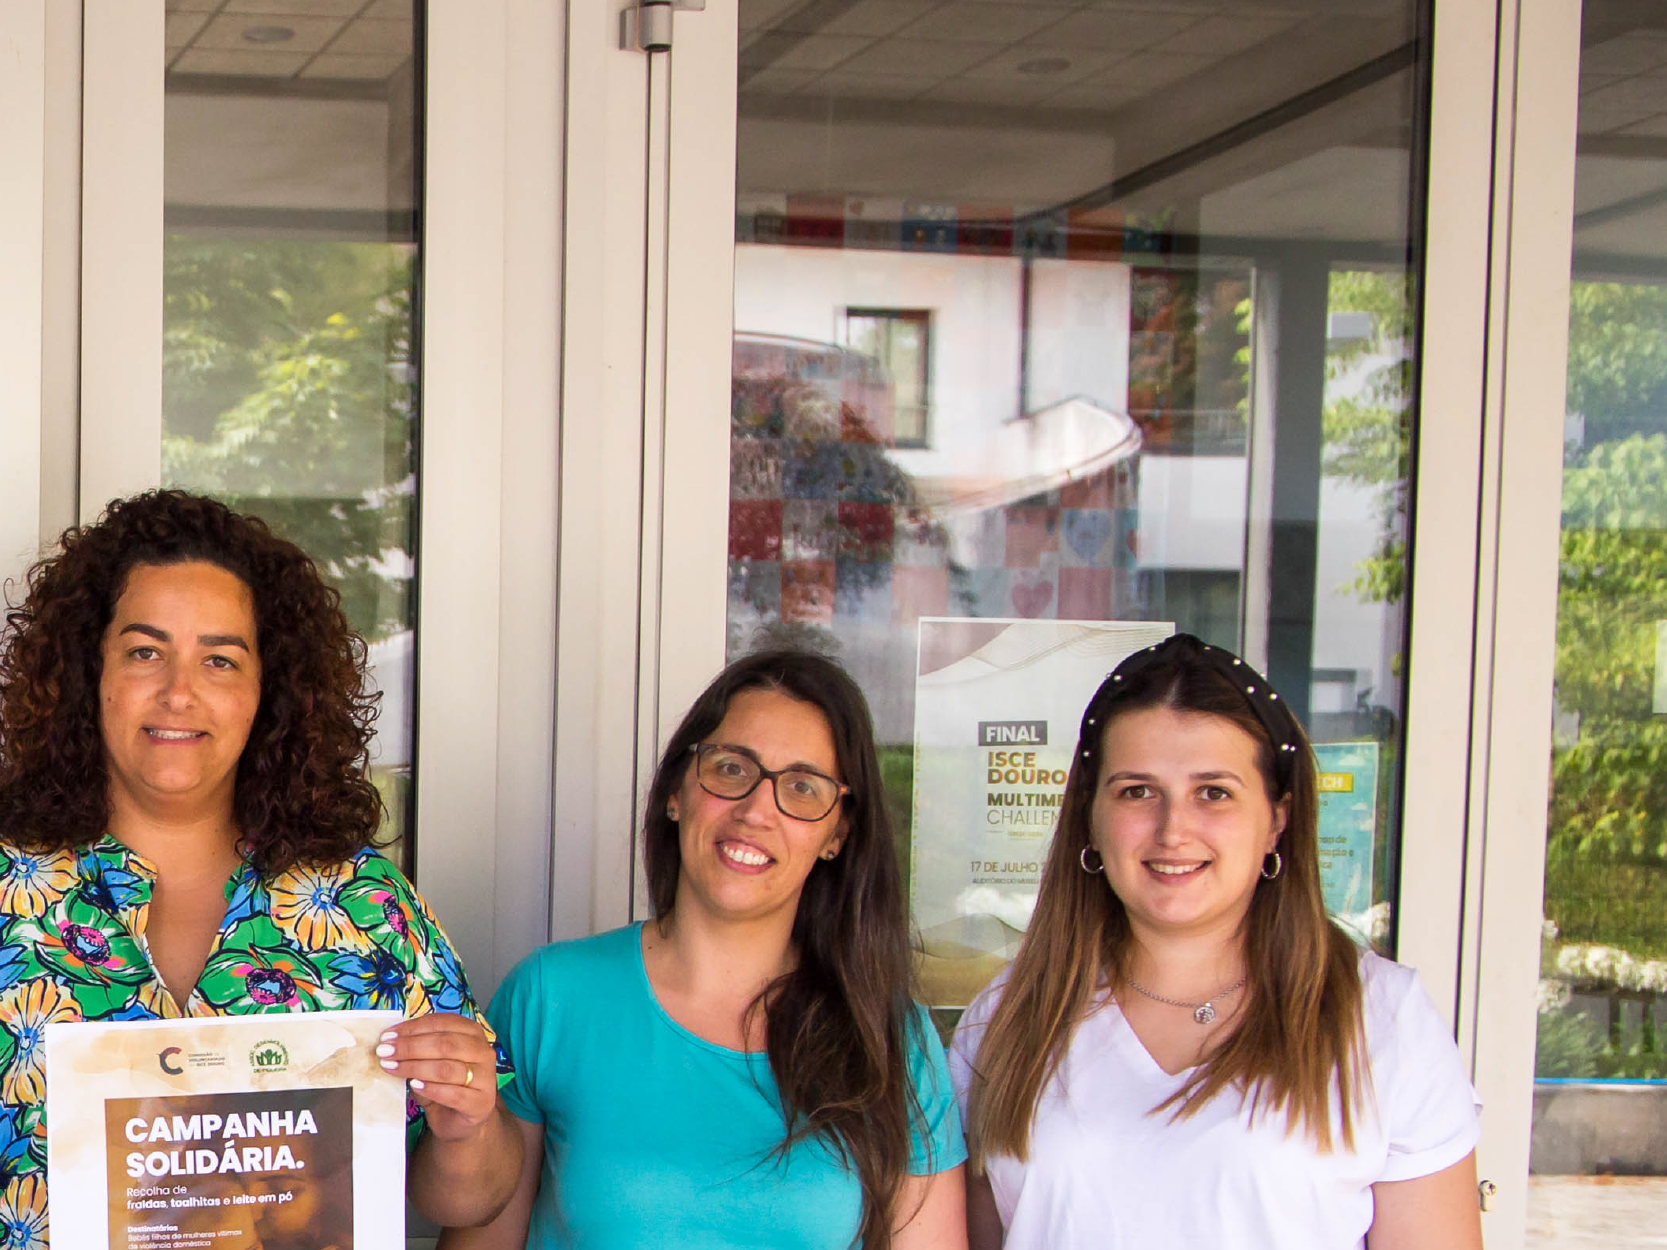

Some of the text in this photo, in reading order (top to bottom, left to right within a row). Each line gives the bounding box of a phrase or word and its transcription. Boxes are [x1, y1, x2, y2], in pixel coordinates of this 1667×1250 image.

[986, 725, 1040, 743] FINAL
[987, 751, 1036, 768] ISCE
[987, 768, 1067, 785] DOURO
[970, 861, 982, 873] 17
[984, 861, 1000, 873] DE
[1000, 861, 1039, 873] JULHO
[125, 1109, 318, 1143] CAMPANHA
[126, 1140, 305, 1178] SOLIDÁRIA.
[127, 1185, 188, 1198] Recolha de
[127, 1198, 169, 1210] fraldas,
[171, 1195, 221, 1208] toalhitas
[233, 1194, 256, 1205] leite
[258, 1194, 276, 1203] em
[279, 1190, 293, 1205] pó
